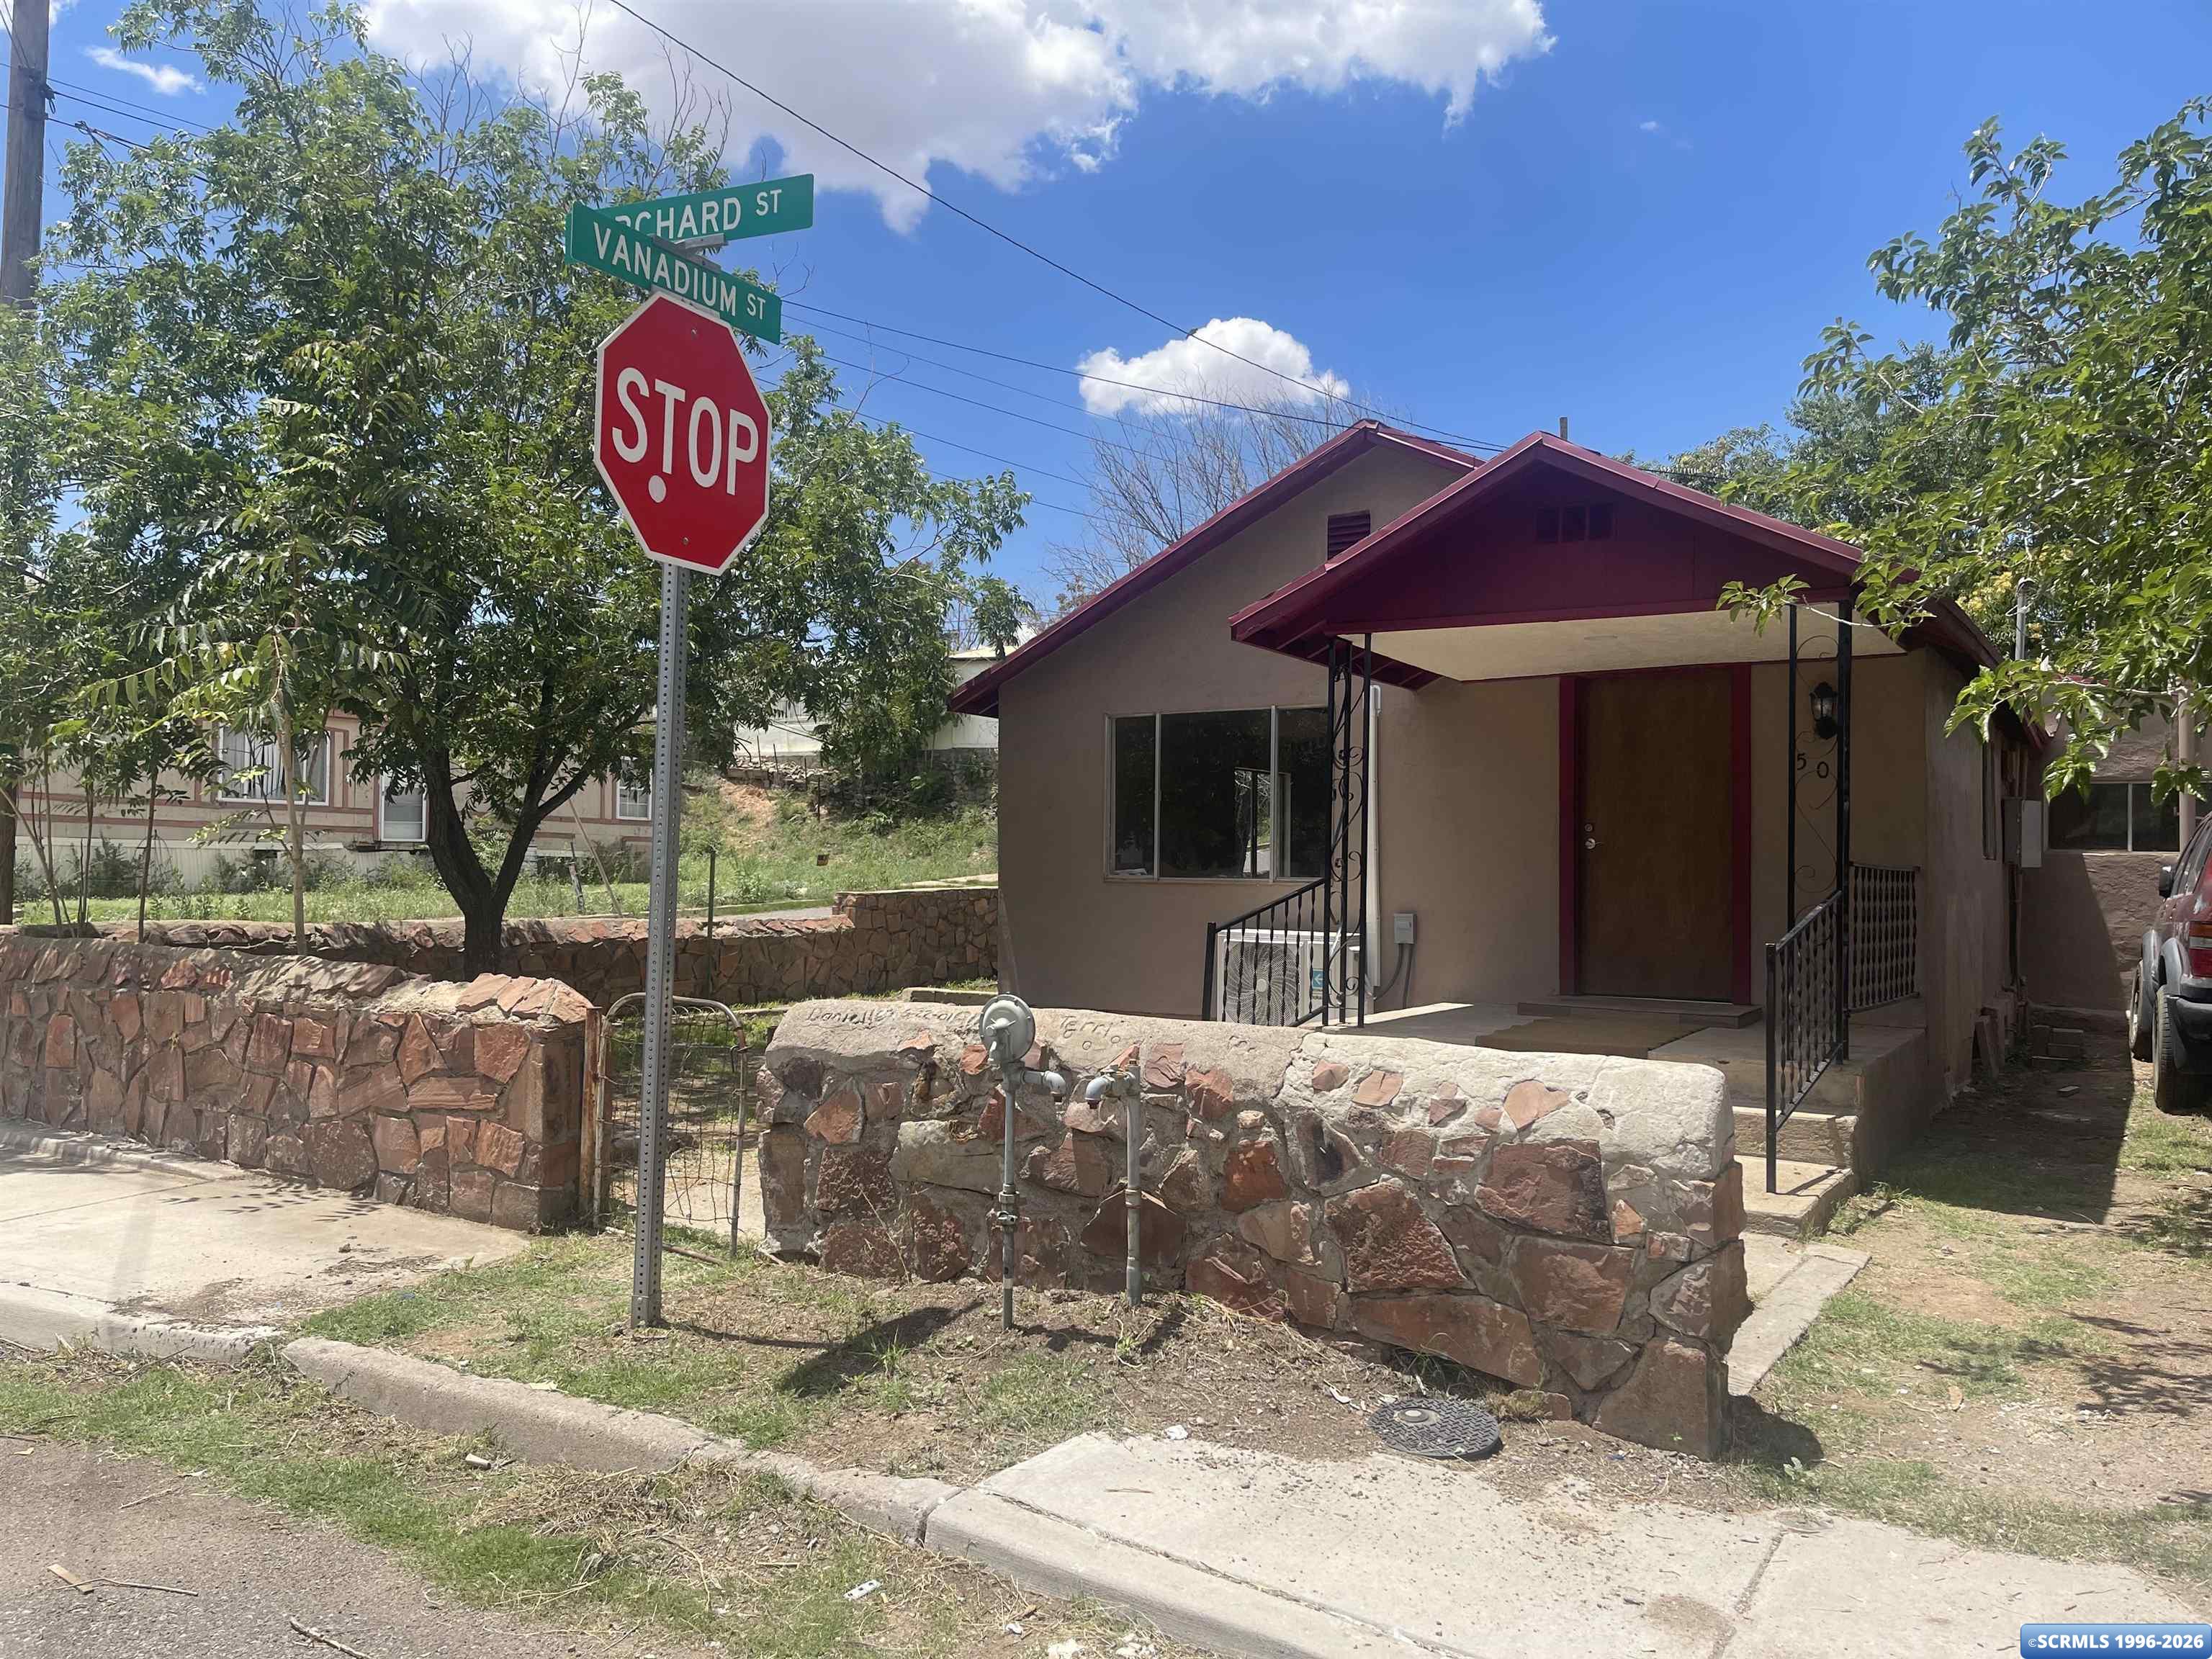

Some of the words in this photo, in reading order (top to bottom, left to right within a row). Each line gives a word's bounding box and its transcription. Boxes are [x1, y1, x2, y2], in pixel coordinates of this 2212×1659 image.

[615, 197, 742, 239] CHARD
[755, 189, 783, 217] ST
[593, 221, 737, 317] VANADIUM
[747, 293, 766, 320] ST
[611, 367, 759, 496] STOP
